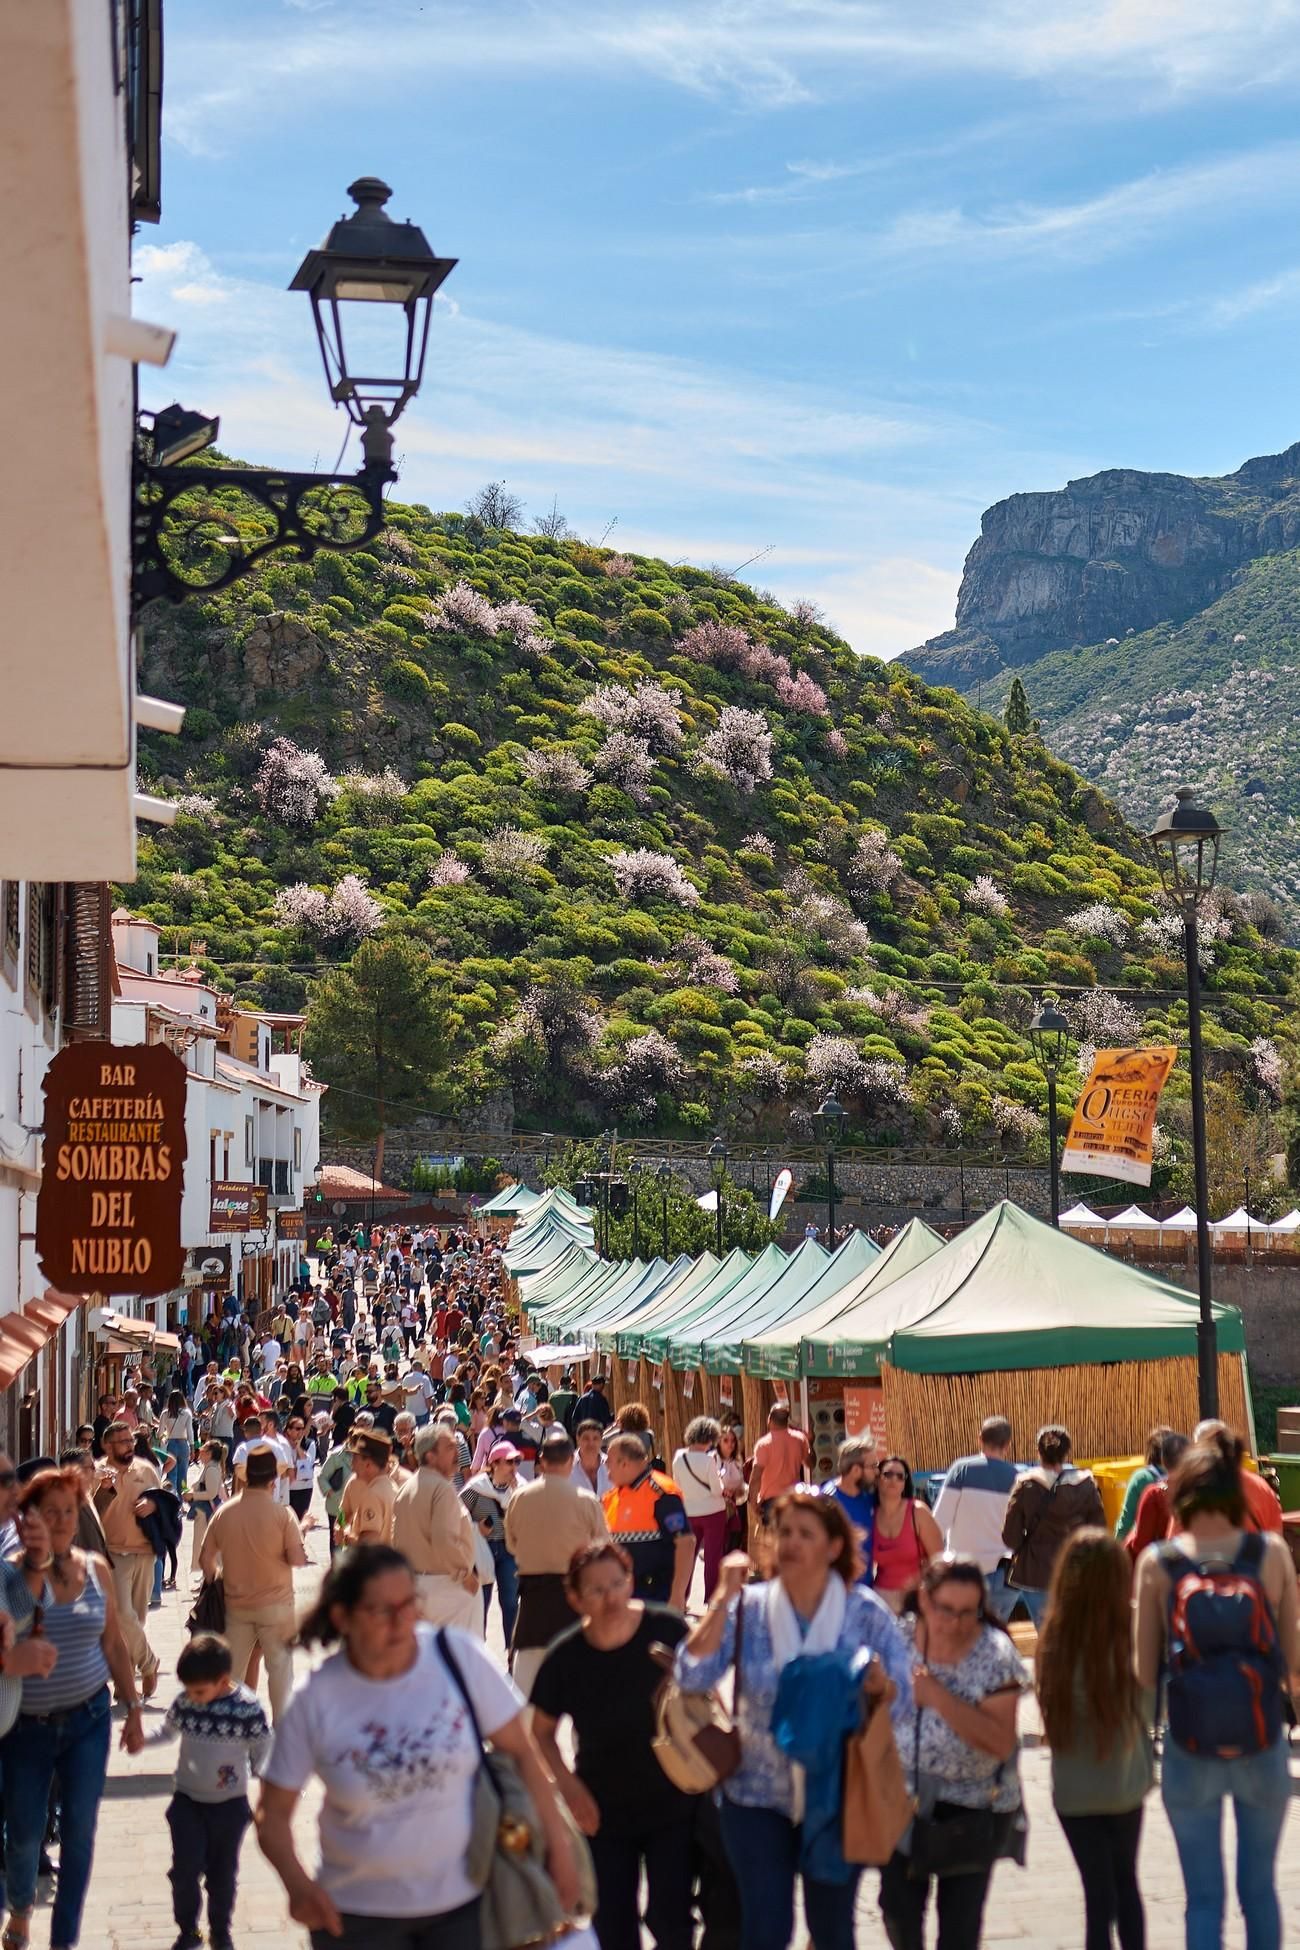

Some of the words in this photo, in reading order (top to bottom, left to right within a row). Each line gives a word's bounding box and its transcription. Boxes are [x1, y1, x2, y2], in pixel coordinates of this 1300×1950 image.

[100, 1065, 136, 1086] BAR
[68, 1092, 165, 1120] CAFETERÍA
[1113, 1088, 1158, 1102] FERIA
[69, 1122, 161, 1144] RESTAURANTE
[56, 1145, 172, 1182] SOMBRAS
[91, 1192, 136, 1228] DEL
[71, 1238, 152, 1275] NUBLO
